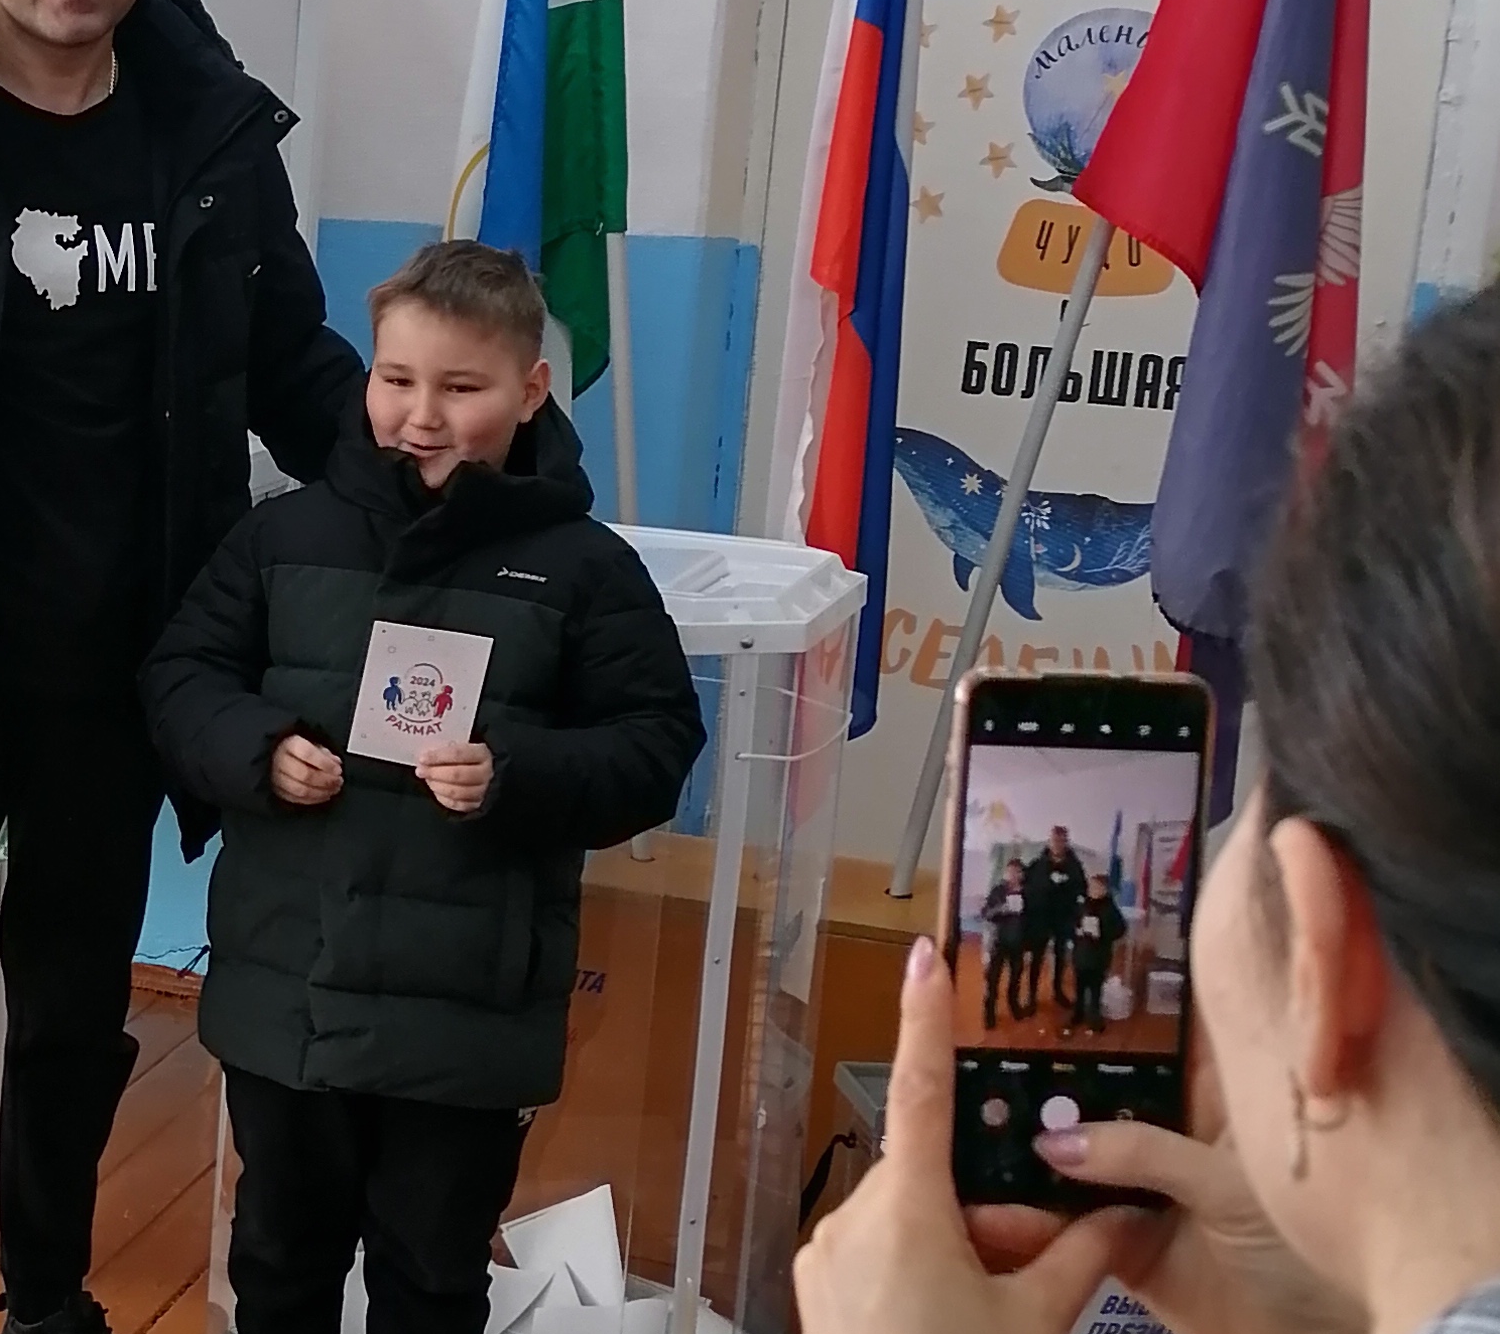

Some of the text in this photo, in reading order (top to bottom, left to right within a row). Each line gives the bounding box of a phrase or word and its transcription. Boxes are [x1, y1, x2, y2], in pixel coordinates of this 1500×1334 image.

[1035, 219, 1142, 270] ЧУО
[410, 675, 436, 687] 2024
[385, 714, 442, 736] РАХМАТ
